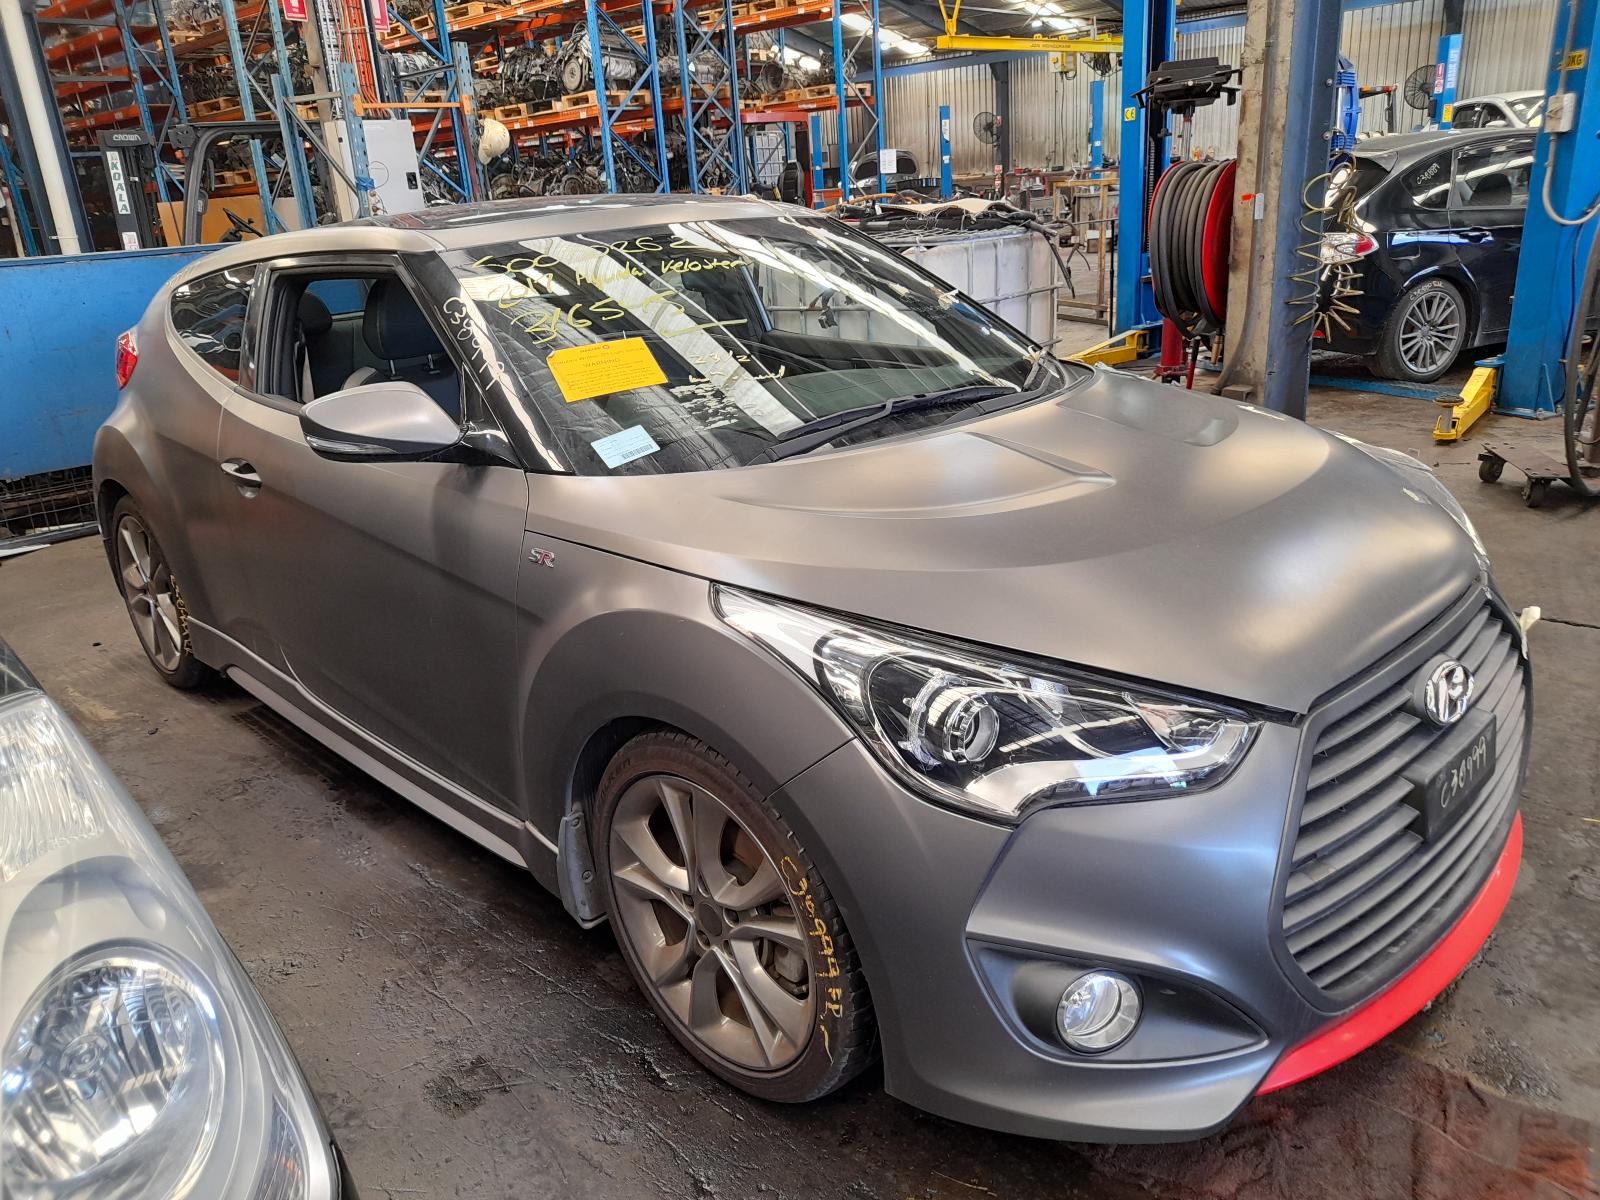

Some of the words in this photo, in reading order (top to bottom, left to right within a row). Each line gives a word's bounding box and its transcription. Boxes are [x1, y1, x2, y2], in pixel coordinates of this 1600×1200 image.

[112, 133, 141, 141] CROWN
[110, 161, 129, 213] KOALA
[528, 547, 555, 568] SR
